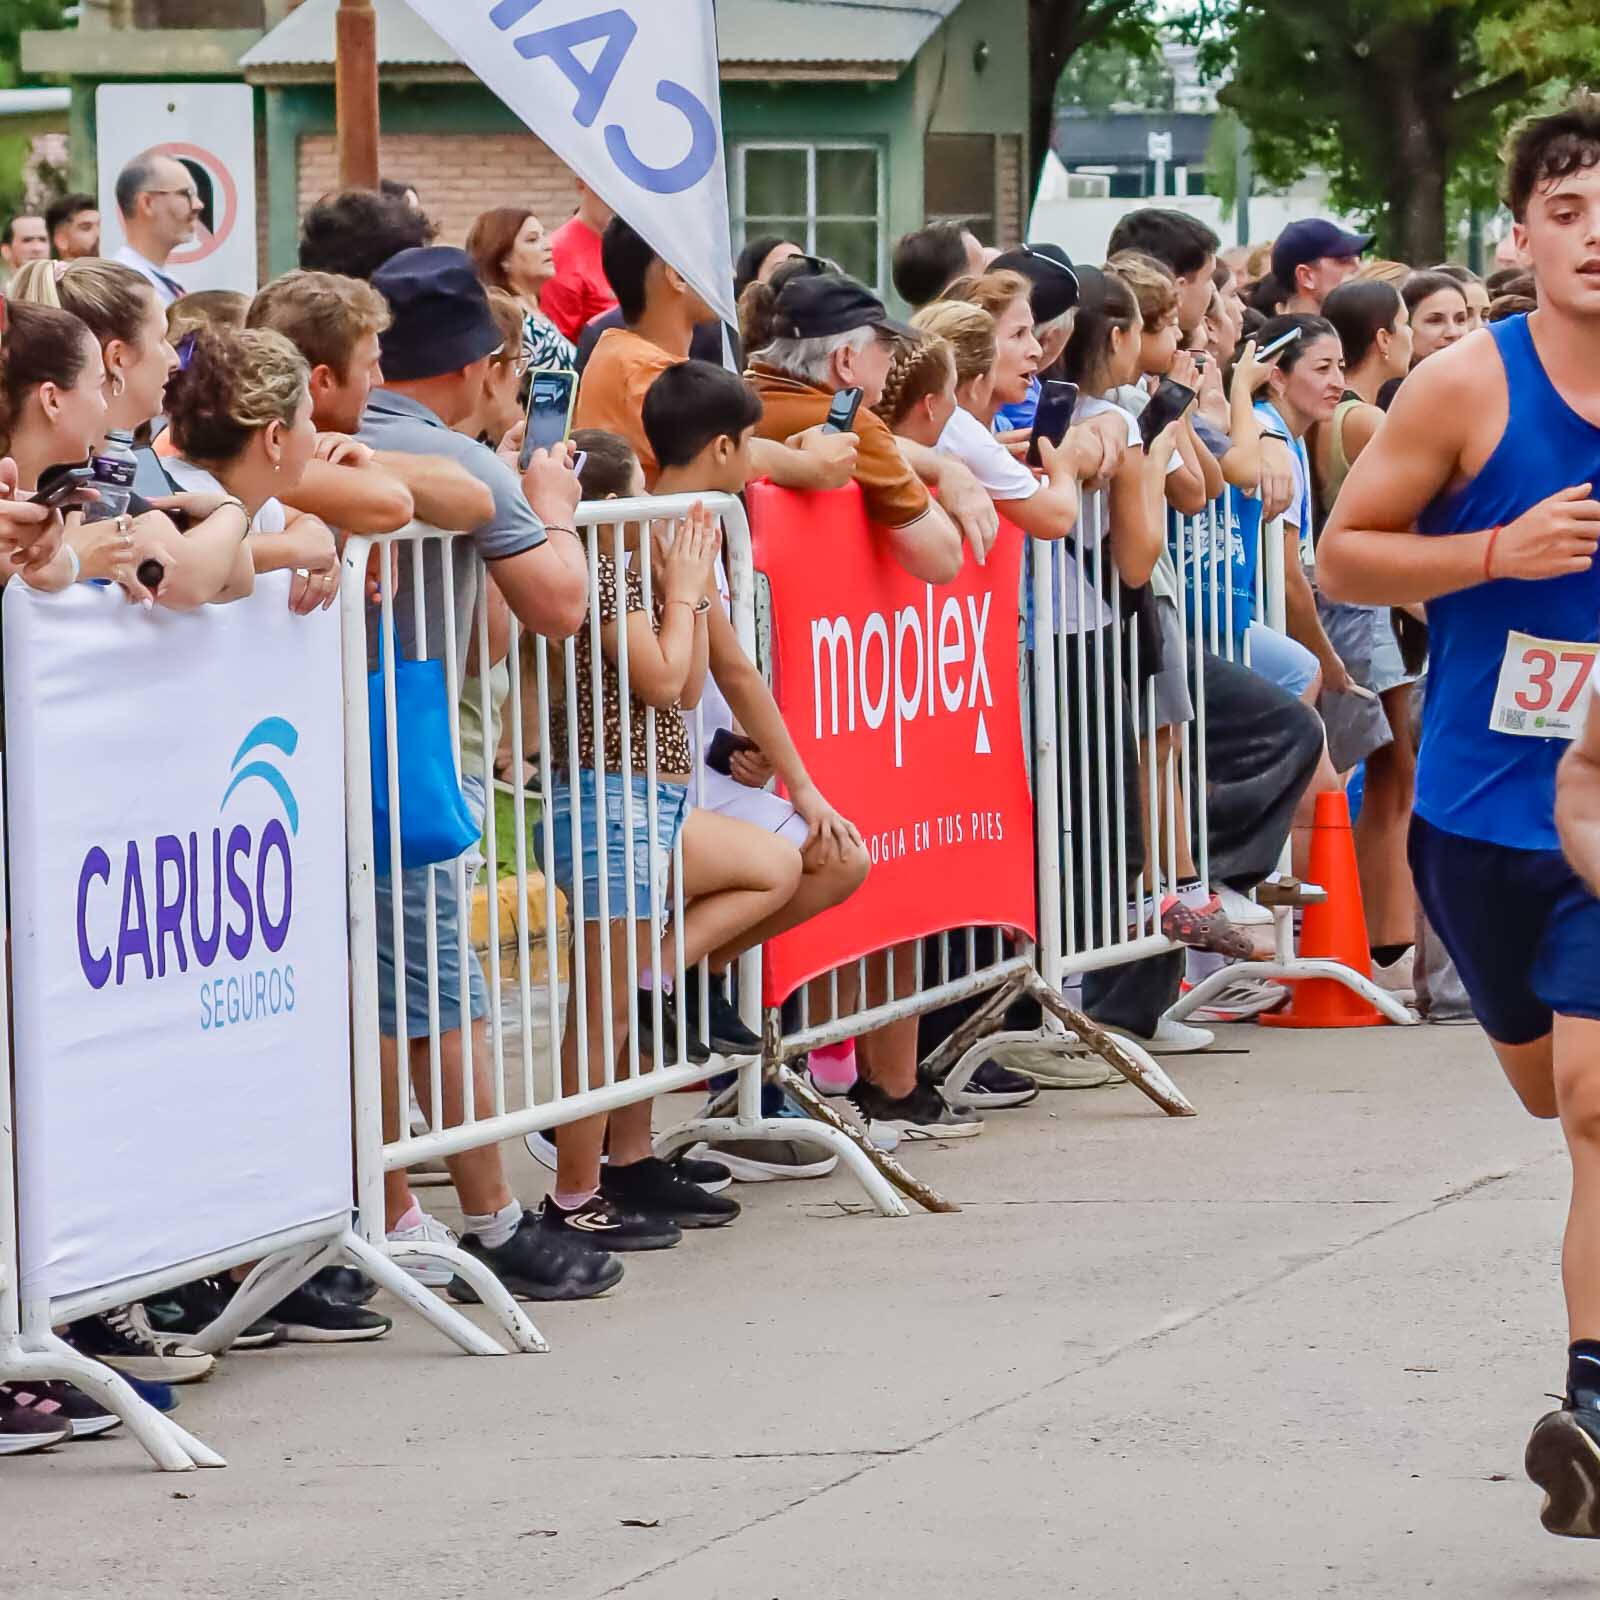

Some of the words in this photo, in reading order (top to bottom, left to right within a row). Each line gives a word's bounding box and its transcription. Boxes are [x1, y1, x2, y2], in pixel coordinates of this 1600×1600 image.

[811, 582, 993, 768] moplex
[914, 820, 930, 852] EN
[937, 813, 963, 846] TUS
[971, 811, 1004, 841] PIES
[77, 818, 292, 989] CARUSO
[200, 964, 296, 1030] SEGUROS
